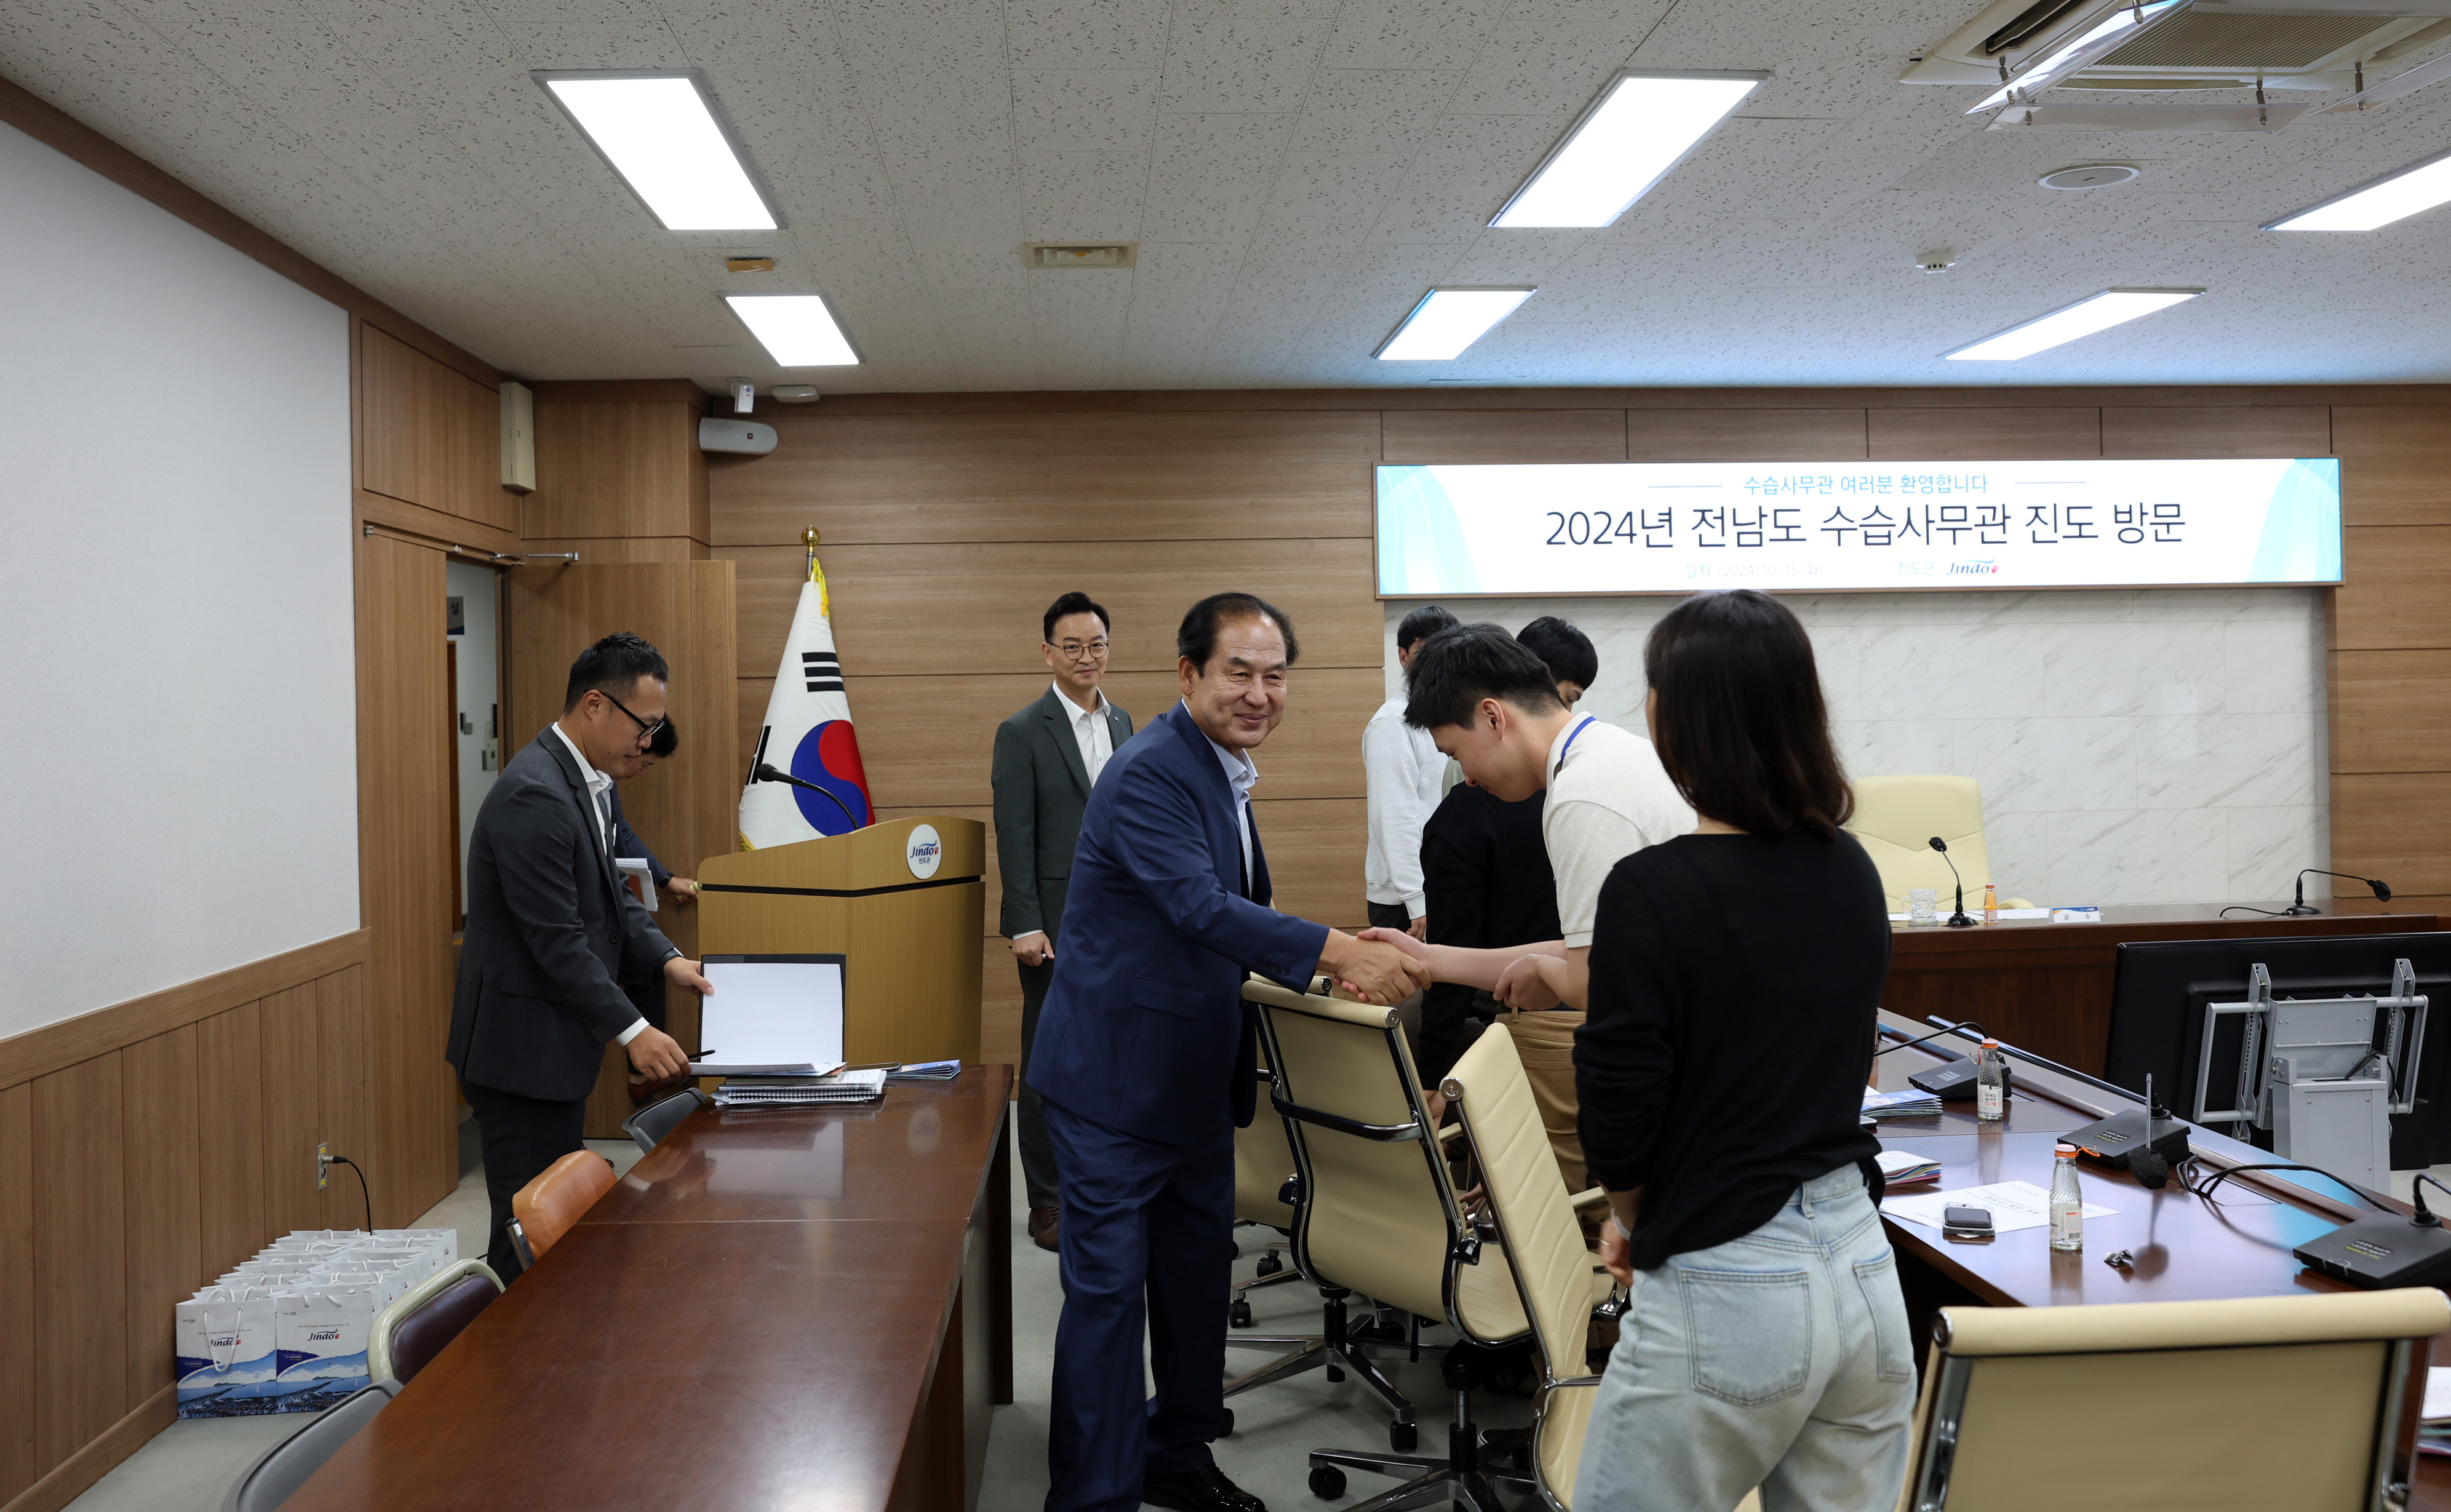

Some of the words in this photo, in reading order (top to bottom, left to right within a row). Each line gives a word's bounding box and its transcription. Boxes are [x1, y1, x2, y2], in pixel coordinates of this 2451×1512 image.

[1744, 475, 1834, 495] 수습사무관
[1841, 475, 1893, 495] 여러분
[1900, 474, 1988, 495] 환영합니다
[1546, 506, 1673, 548] 2024년
[1691, 505, 1807, 547] 전남도
[1820, 504, 2012, 547] 수습사무관
[2025, 503, 2099, 544] 진도
[2114, 502, 2186, 544] 방문
[1684, 563, 1713, 579] 일자
[1724, 565, 1756, 578] 2024.
[1763, 564, 1779, 576] 10.
[1897, 562, 1935, 576] 진도군
[1945, 559, 1992, 576] Jindo
[910, 843, 935, 858] Jindo
[308, 1331, 335, 1341] Jindo
